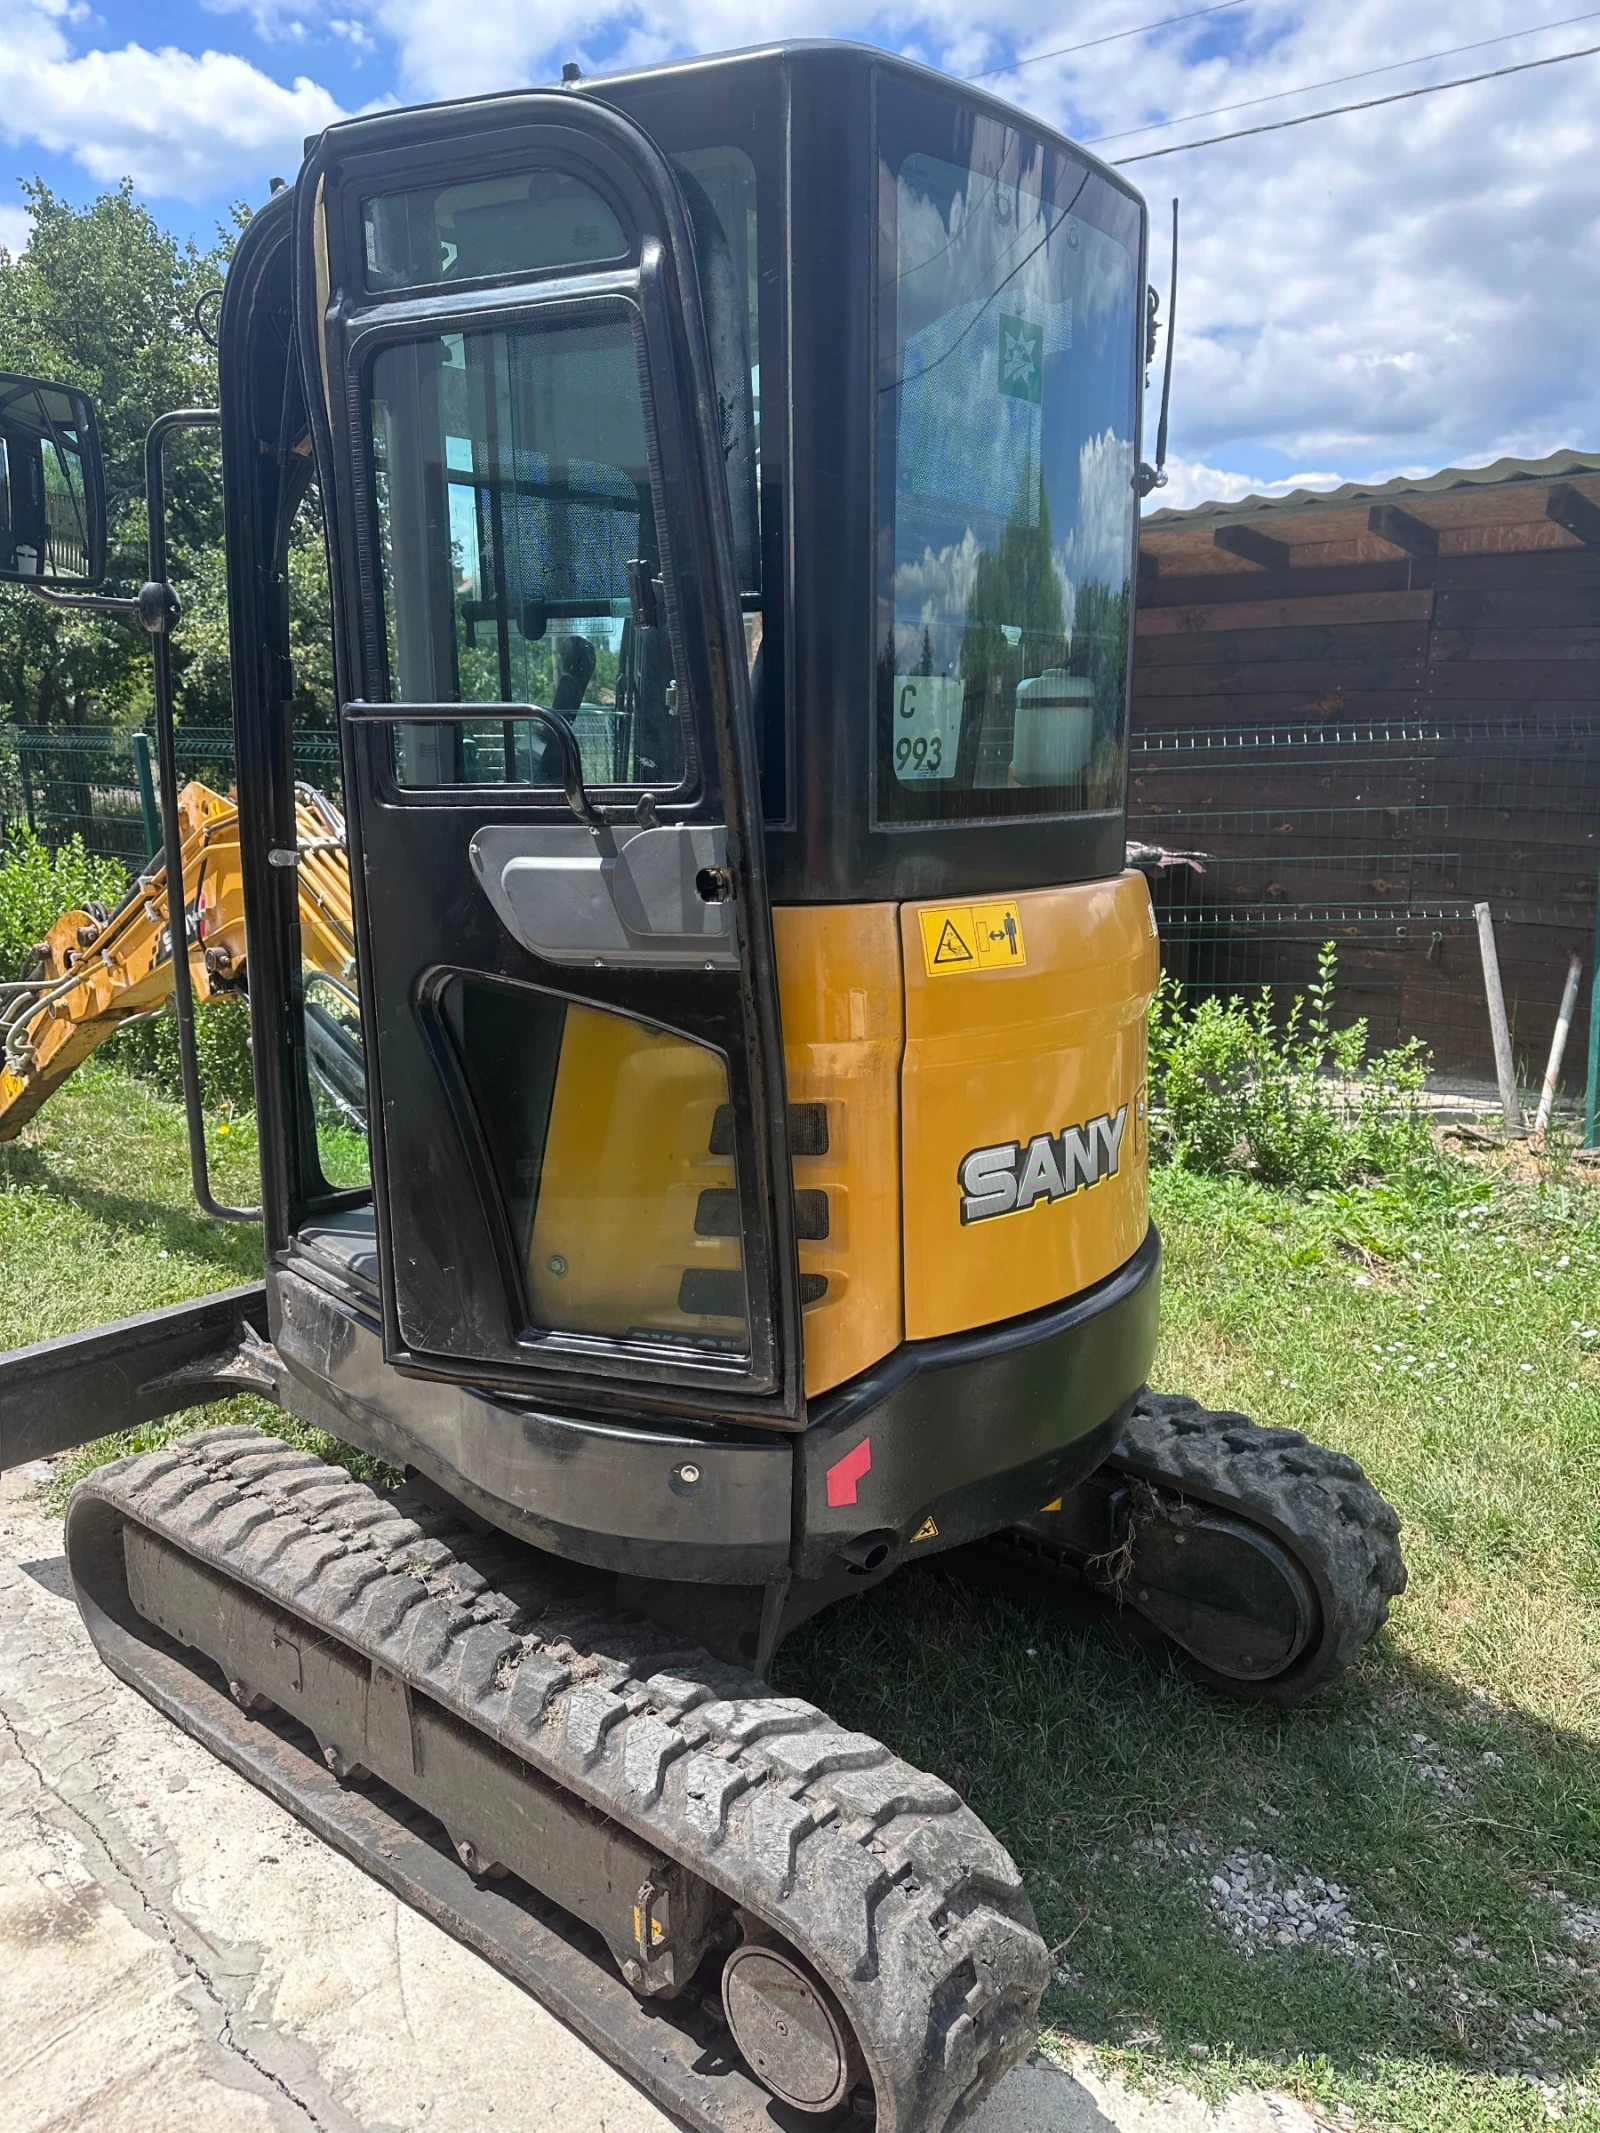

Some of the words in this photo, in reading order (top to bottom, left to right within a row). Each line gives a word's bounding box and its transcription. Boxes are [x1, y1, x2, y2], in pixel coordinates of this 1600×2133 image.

[900, 684, 917, 718] C
[896, 737, 942, 771] 993
[959, 1104, 1128, 1223] SANY
